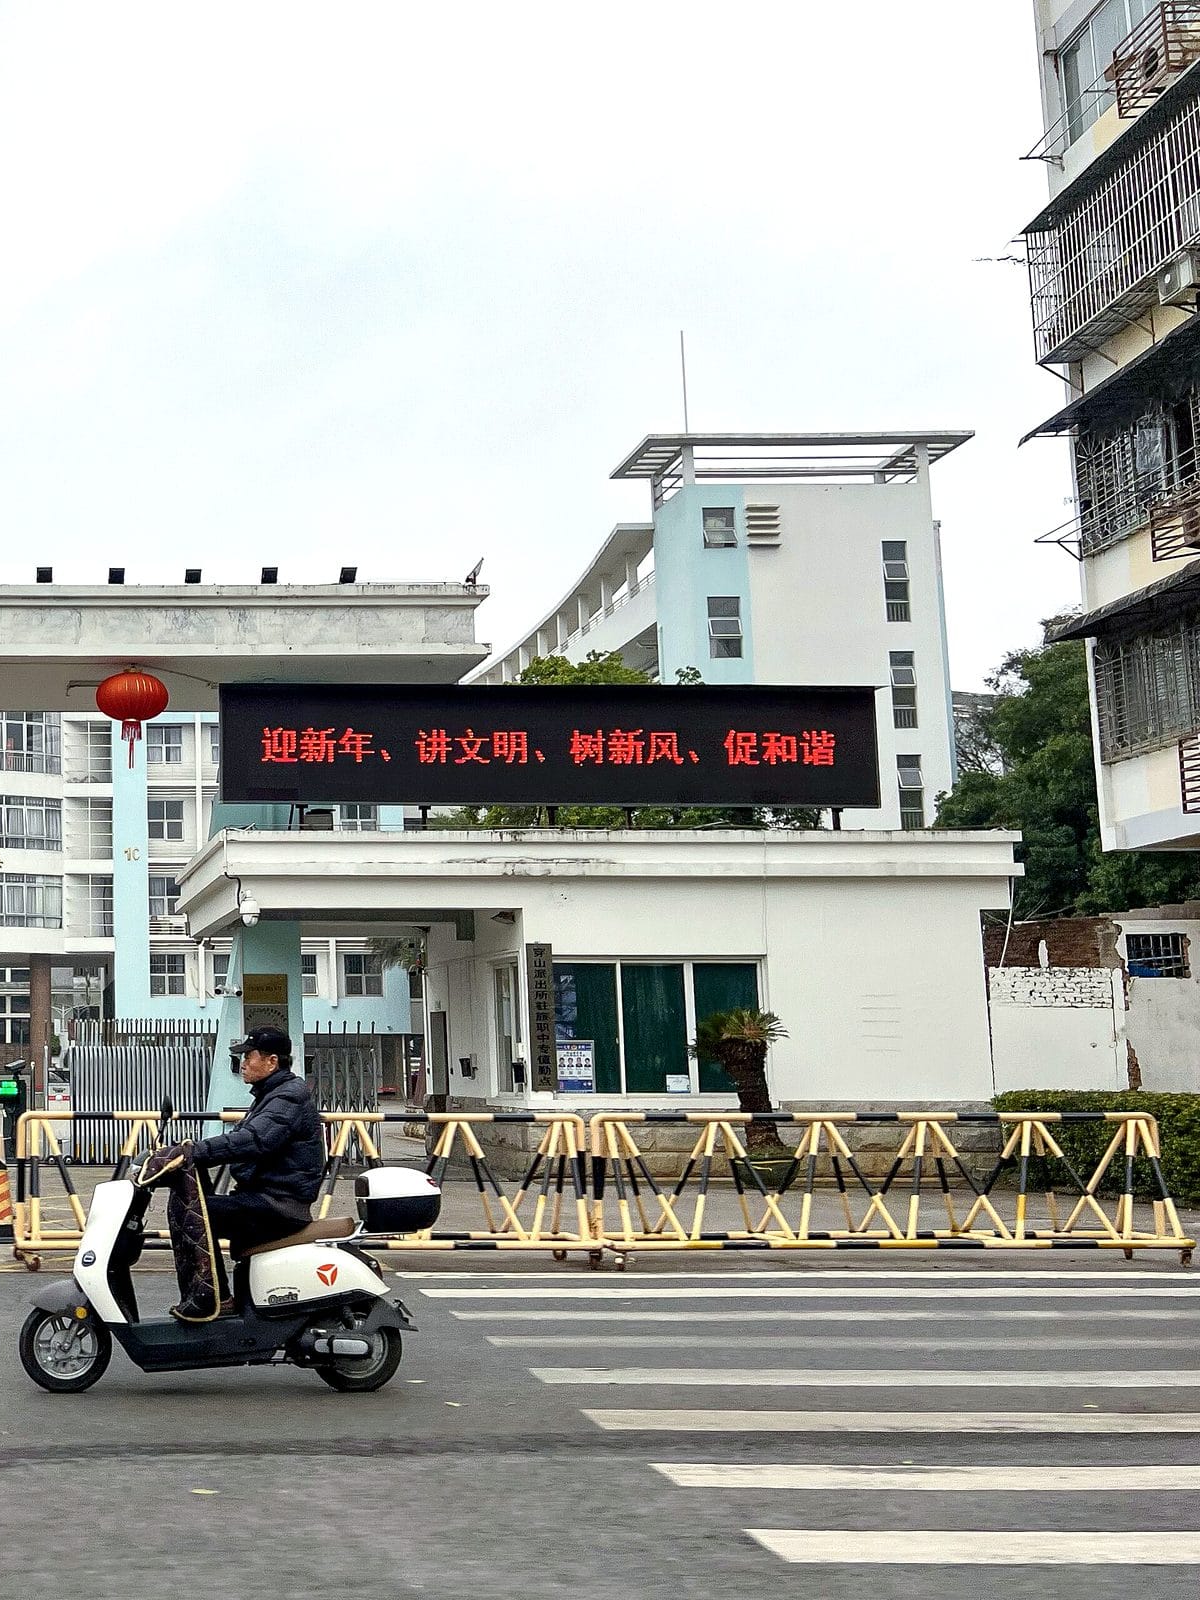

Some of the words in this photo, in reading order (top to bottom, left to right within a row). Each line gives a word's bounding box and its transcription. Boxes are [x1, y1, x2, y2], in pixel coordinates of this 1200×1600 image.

[261, 727, 835, 767] 迎新年、讲文明、树新风、促和谐
